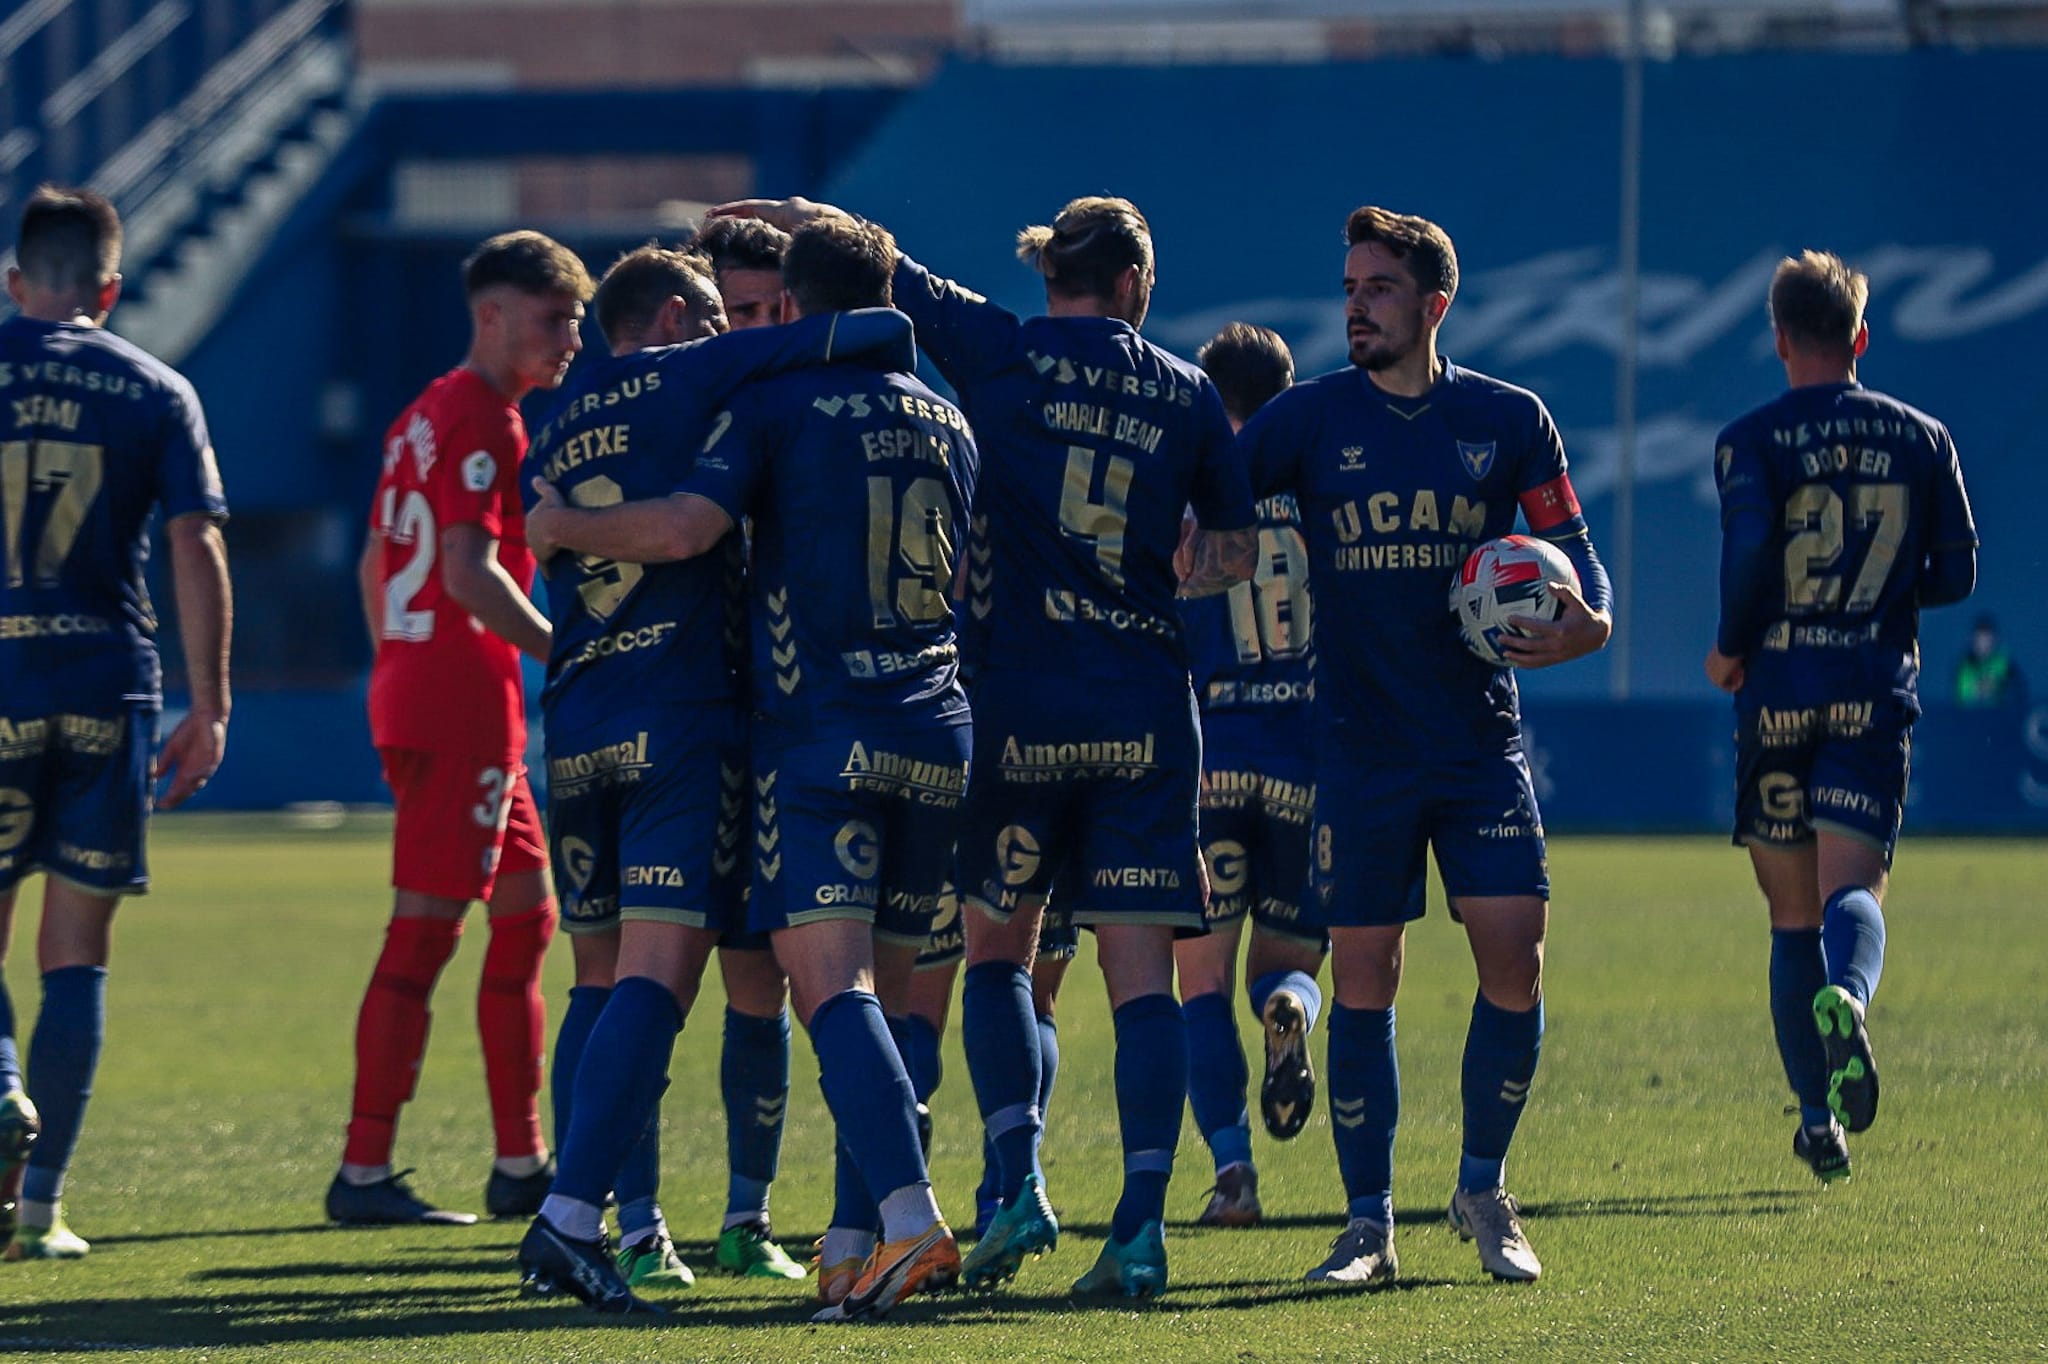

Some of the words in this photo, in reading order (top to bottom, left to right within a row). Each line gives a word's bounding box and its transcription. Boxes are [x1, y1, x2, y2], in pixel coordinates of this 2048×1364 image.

[22, 361, 144, 400] VERSUS
[1084, 365, 1192, 408] VERSUS
[1043, 402, 1112, 436] CHARLIE
[1113, 413, 1163, 454] DEAN
[1817, 418, 1917, 442] VERSUS
[2, 440, 104, 588] 17
[1059, 446, 1134, 587] 4
[1332, 489, 1487, 544] UCAM
[867, 476, 953, 629] 19
[1785, 484, 1909, 613] 27
[1227, 526, 1311, 663] 18
[1001, 733, 1155, 764] Amounal
[1004, 767, 1063, 783] RENT
[1318, 824, 1332, 872] 8
